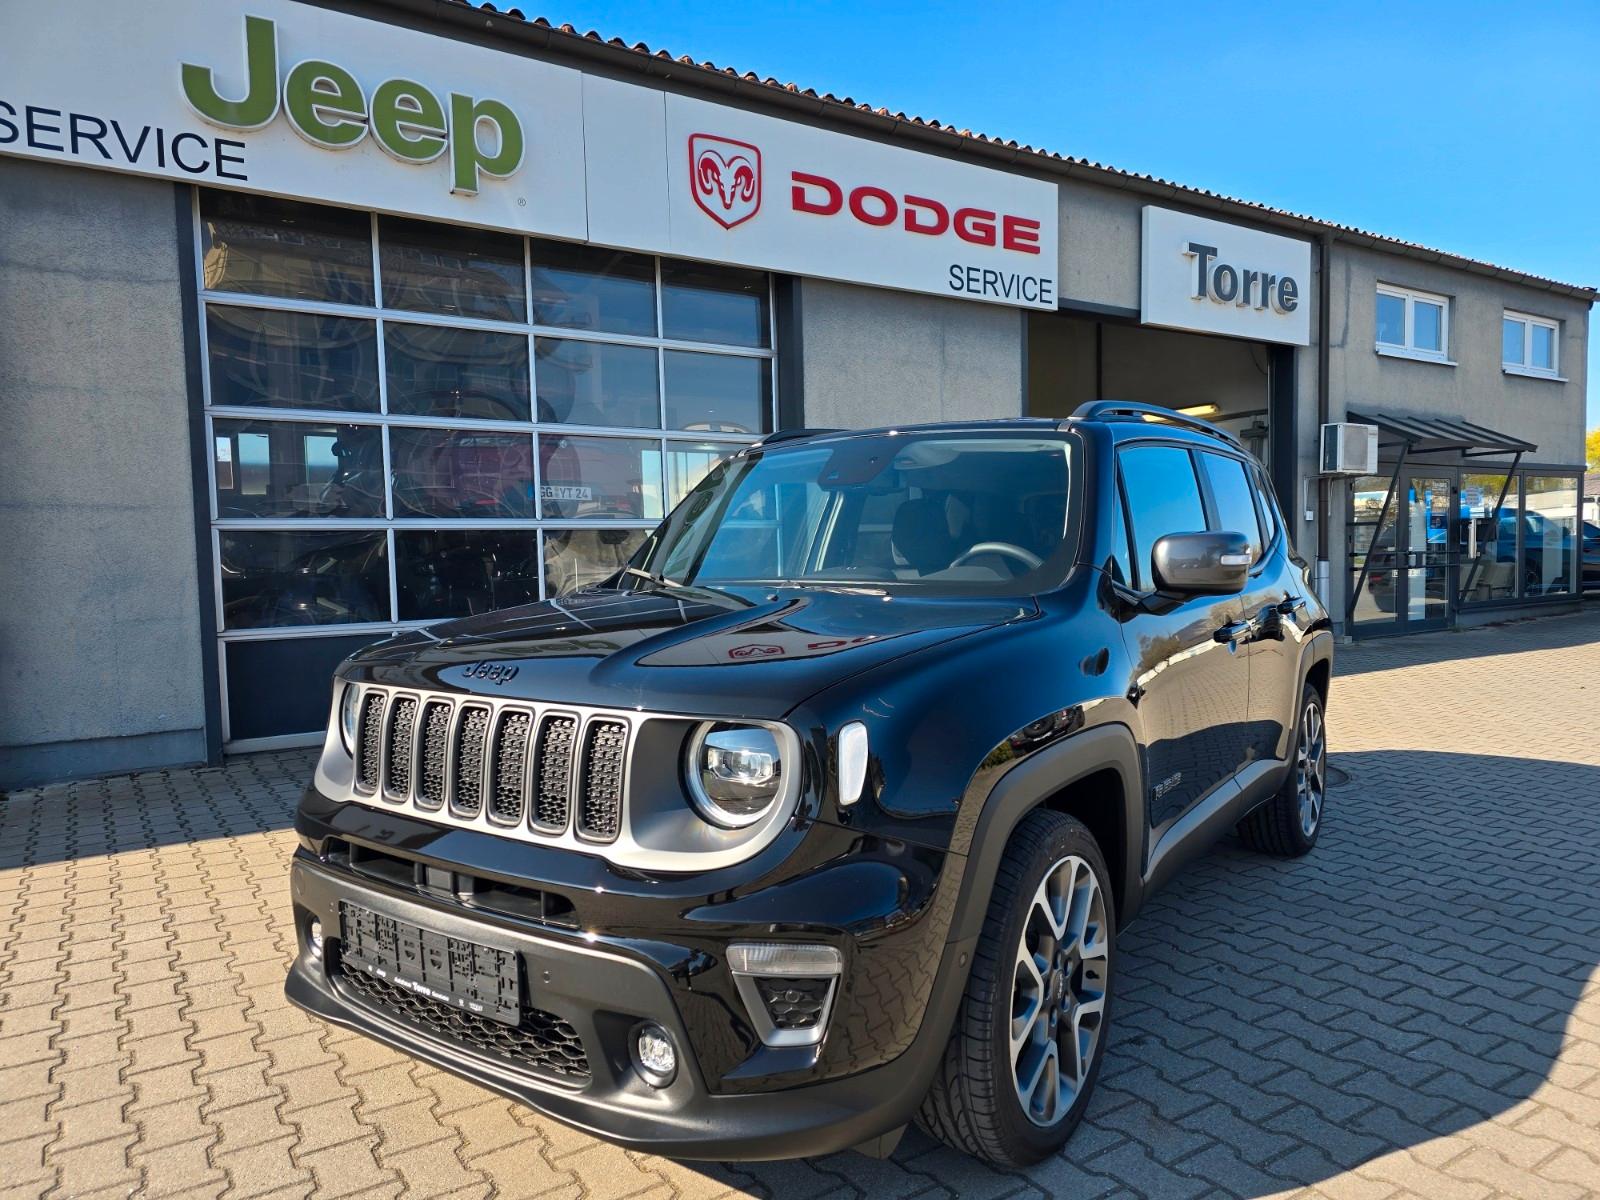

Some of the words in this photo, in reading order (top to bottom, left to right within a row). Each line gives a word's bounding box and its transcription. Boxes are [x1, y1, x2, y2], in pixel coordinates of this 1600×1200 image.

[180, 15, 524, 195] Jeep
[0, 101, 248, 181] SERVICE
[791, 171, 1041, 254] DODGE
[949, 264, 1053, 304] SERVICE
[1184, 242, 1299, 313] Torre
[560, 487, 573, 498] YT
[575, 488, 588, 498] 24
[463, 660, 519, 685] Jeep
